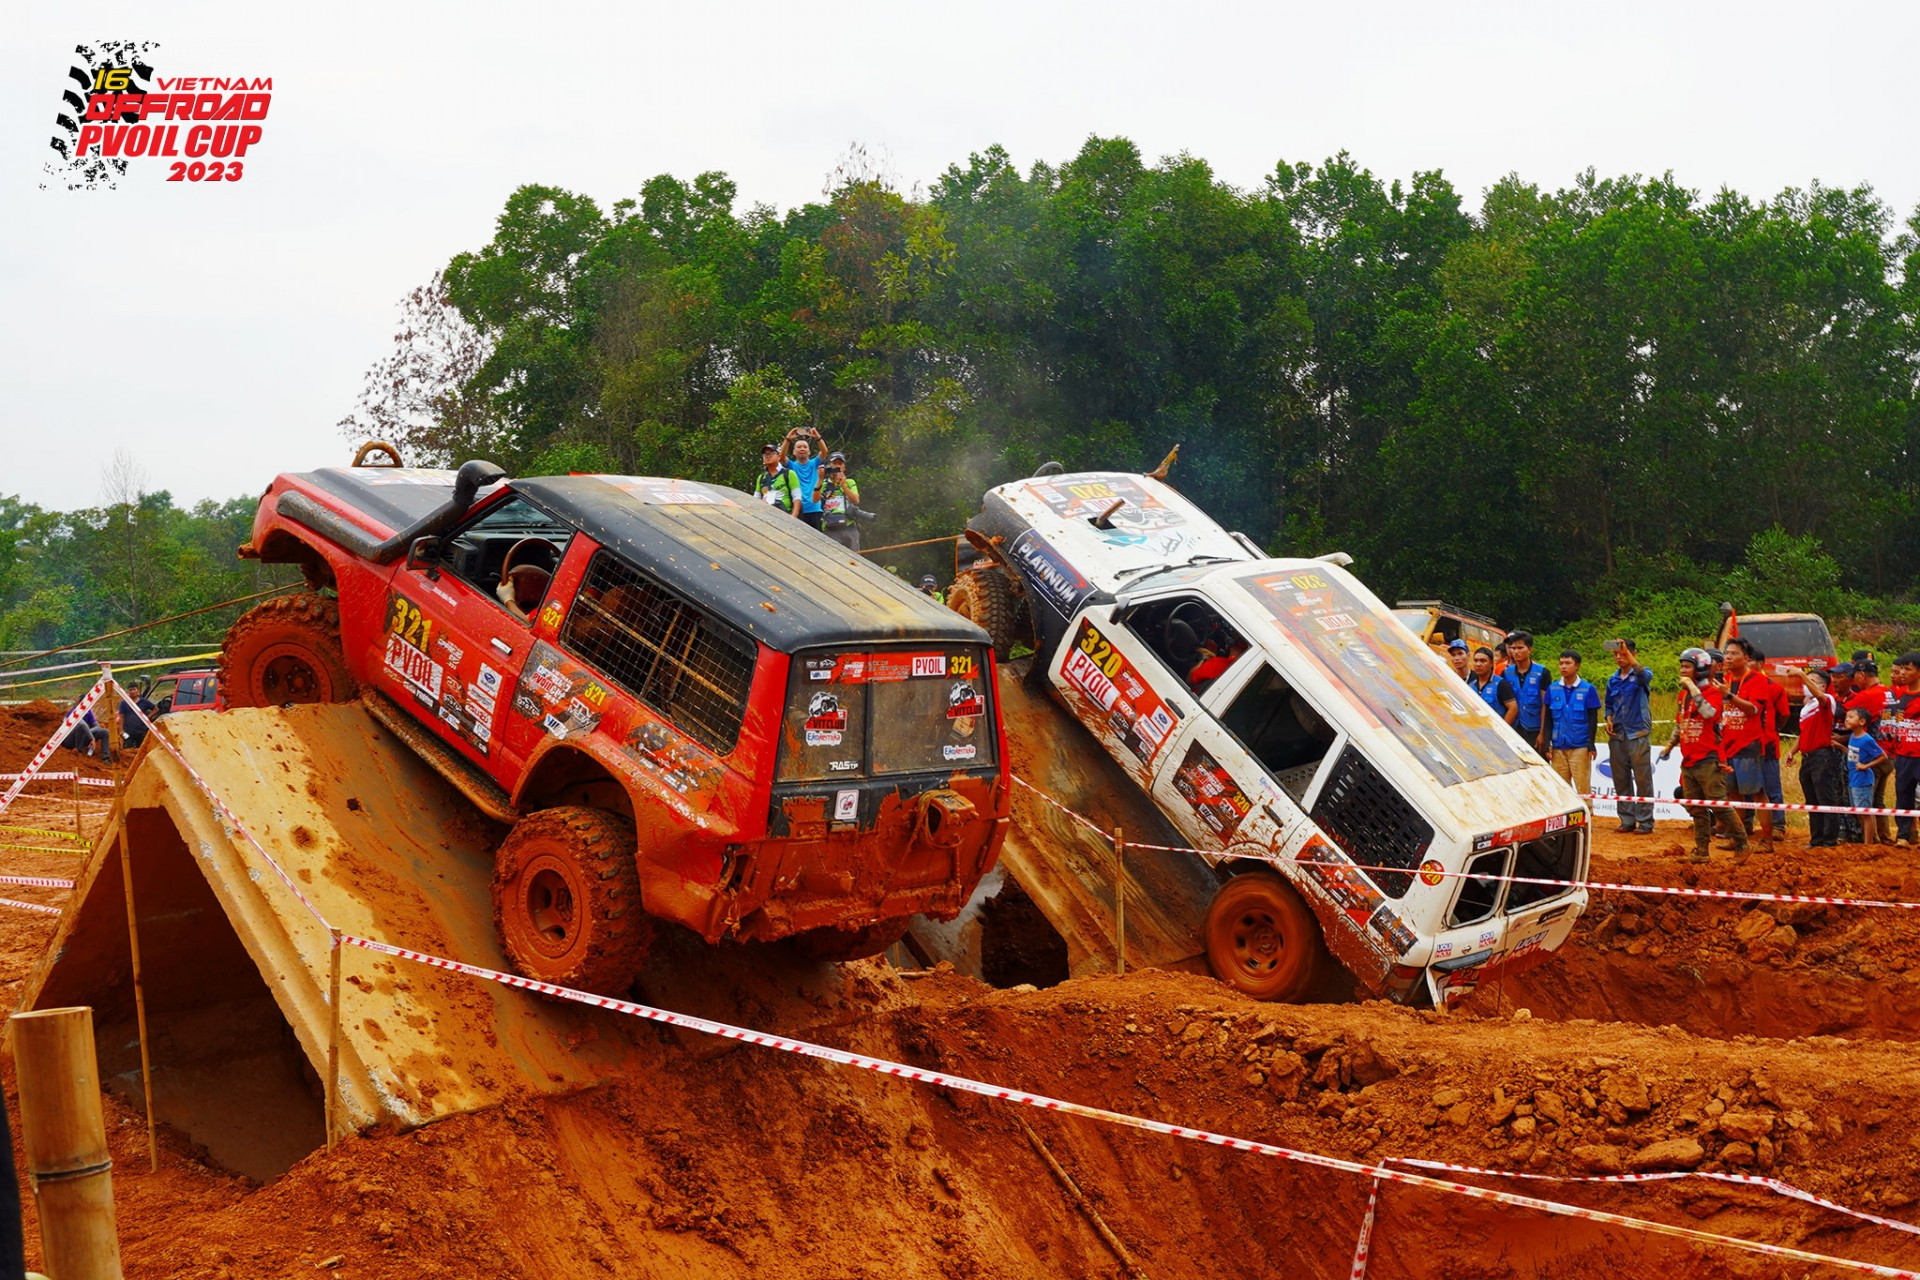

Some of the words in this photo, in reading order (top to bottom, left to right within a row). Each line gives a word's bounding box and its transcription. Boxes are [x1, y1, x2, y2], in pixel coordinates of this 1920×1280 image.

[1068, 484, 1116, 498] 320
[1018, 542, 1078, 603] PLATINUM
[1290, 575, 1327, 590] 320
[391, 598, 432, 653] 321
[542, 606, 562, 628] 321
[1319, 615, 1354, 629] PVOIL
[390, 637, 434, 692] PVOIL
[1081, 628, 1123, 678] 320
[915, 658, 942, 674] PVOIL
[951, 656, 972, 675] 321
[532, 672, 551, 691] PVOIL
[549, 682, 566, 700] CUP
[1072, 654, 1112, 706] PVOIL
[584, 681, 606, 707] 321
[1233, 791, 1251, 813] 320
[1547, 815, 1565, 832] PVOIL
[1568, 811, 1584, 826] 320
